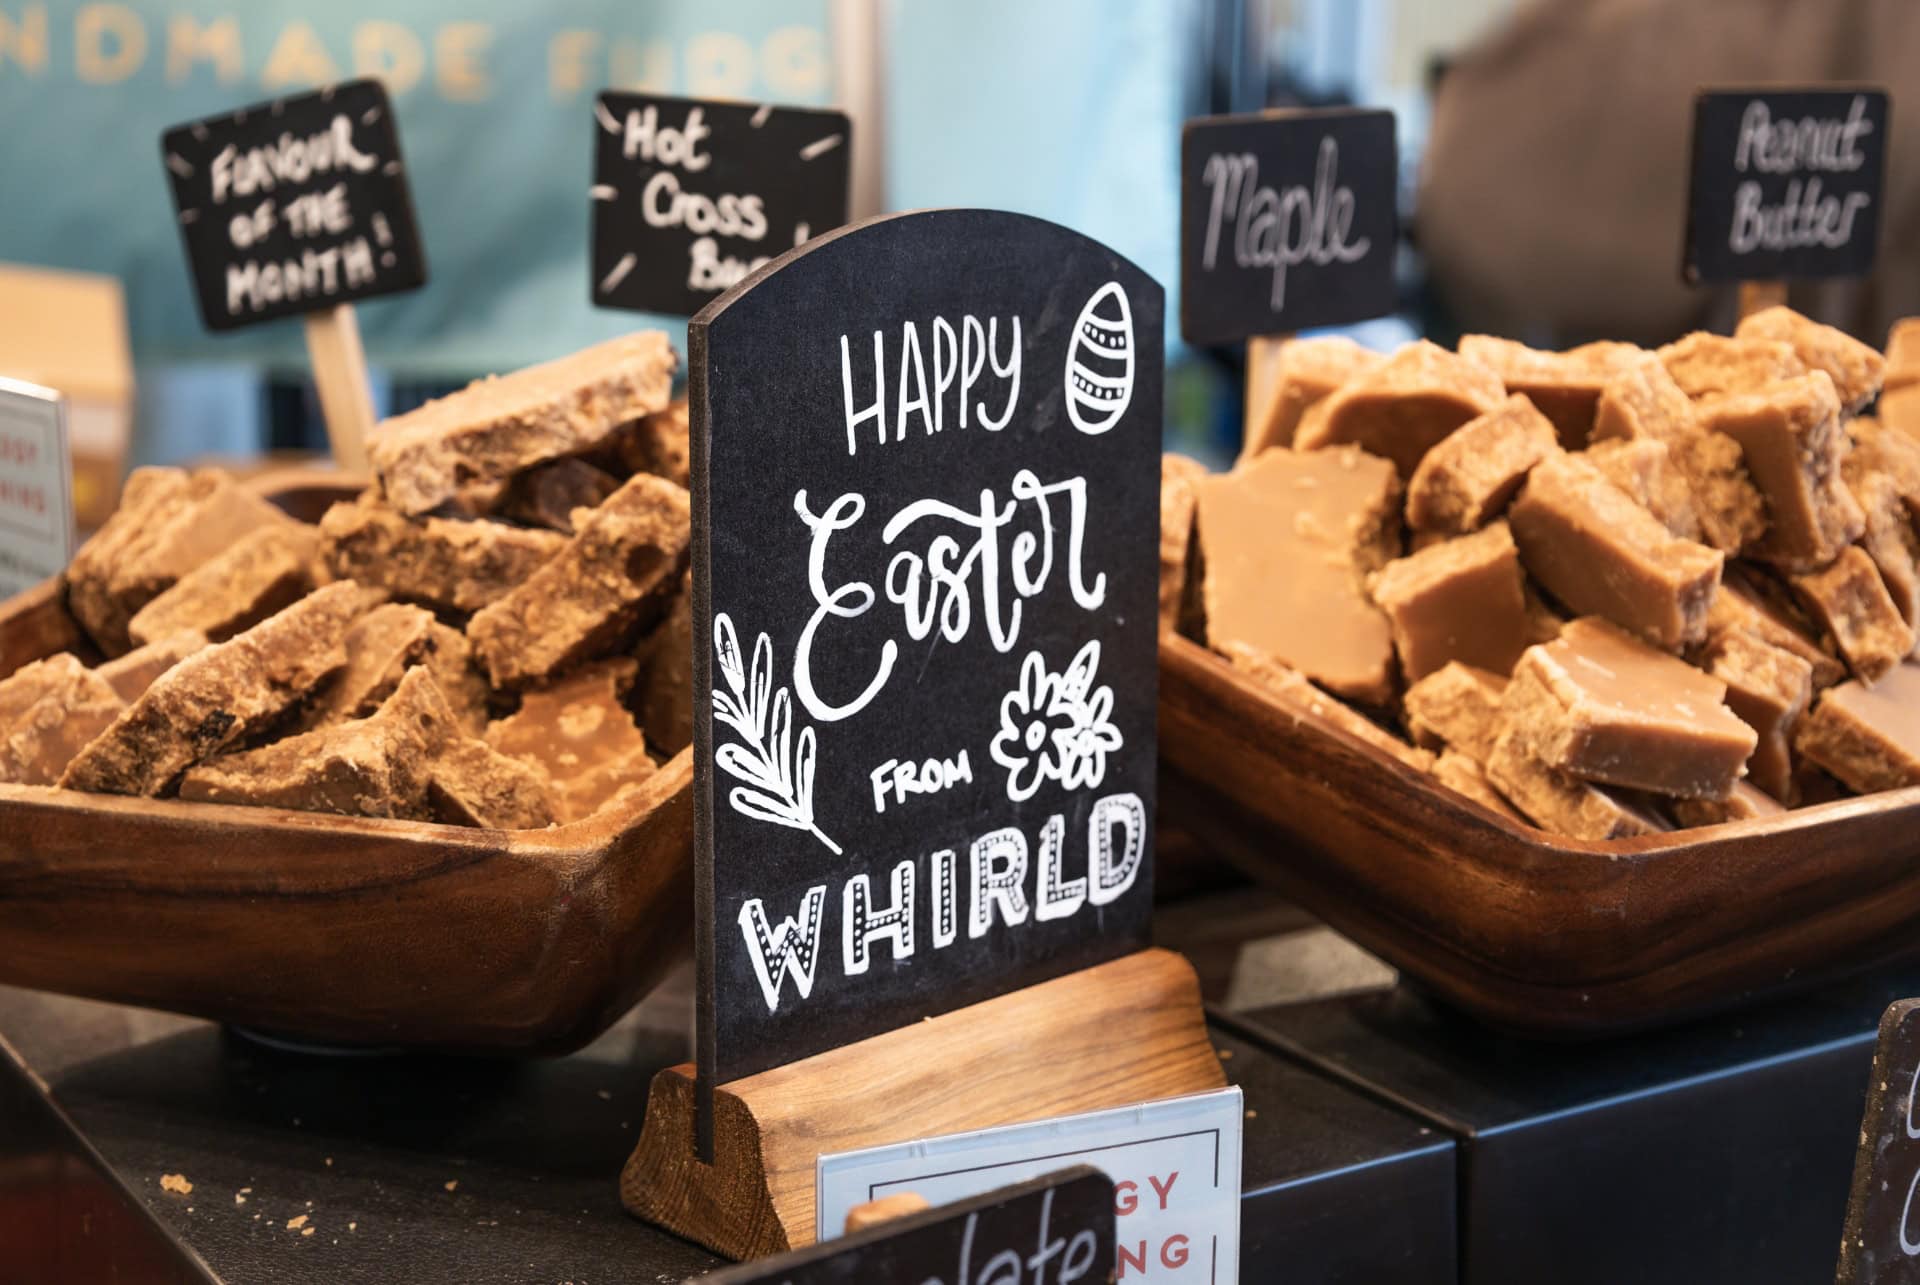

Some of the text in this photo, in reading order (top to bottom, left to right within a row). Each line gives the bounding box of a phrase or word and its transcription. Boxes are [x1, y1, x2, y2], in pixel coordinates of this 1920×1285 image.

[623, 105, 711, 171] Hot
[1734, 95, 1874, 174] Peanut
[284, 182, 353, 236] THE
[642, 172, 769, 241] Cross
[1202, 136, 1372, 313] Maple
[1728, 175, 1872, 255] Butter
[841, 314, 1022, 456] HAPPY
[793, 469, 1106, 722] Easter
[870, 749, 973, 813] FROM
[738, 792, 1146, 1011] WHIRLD
